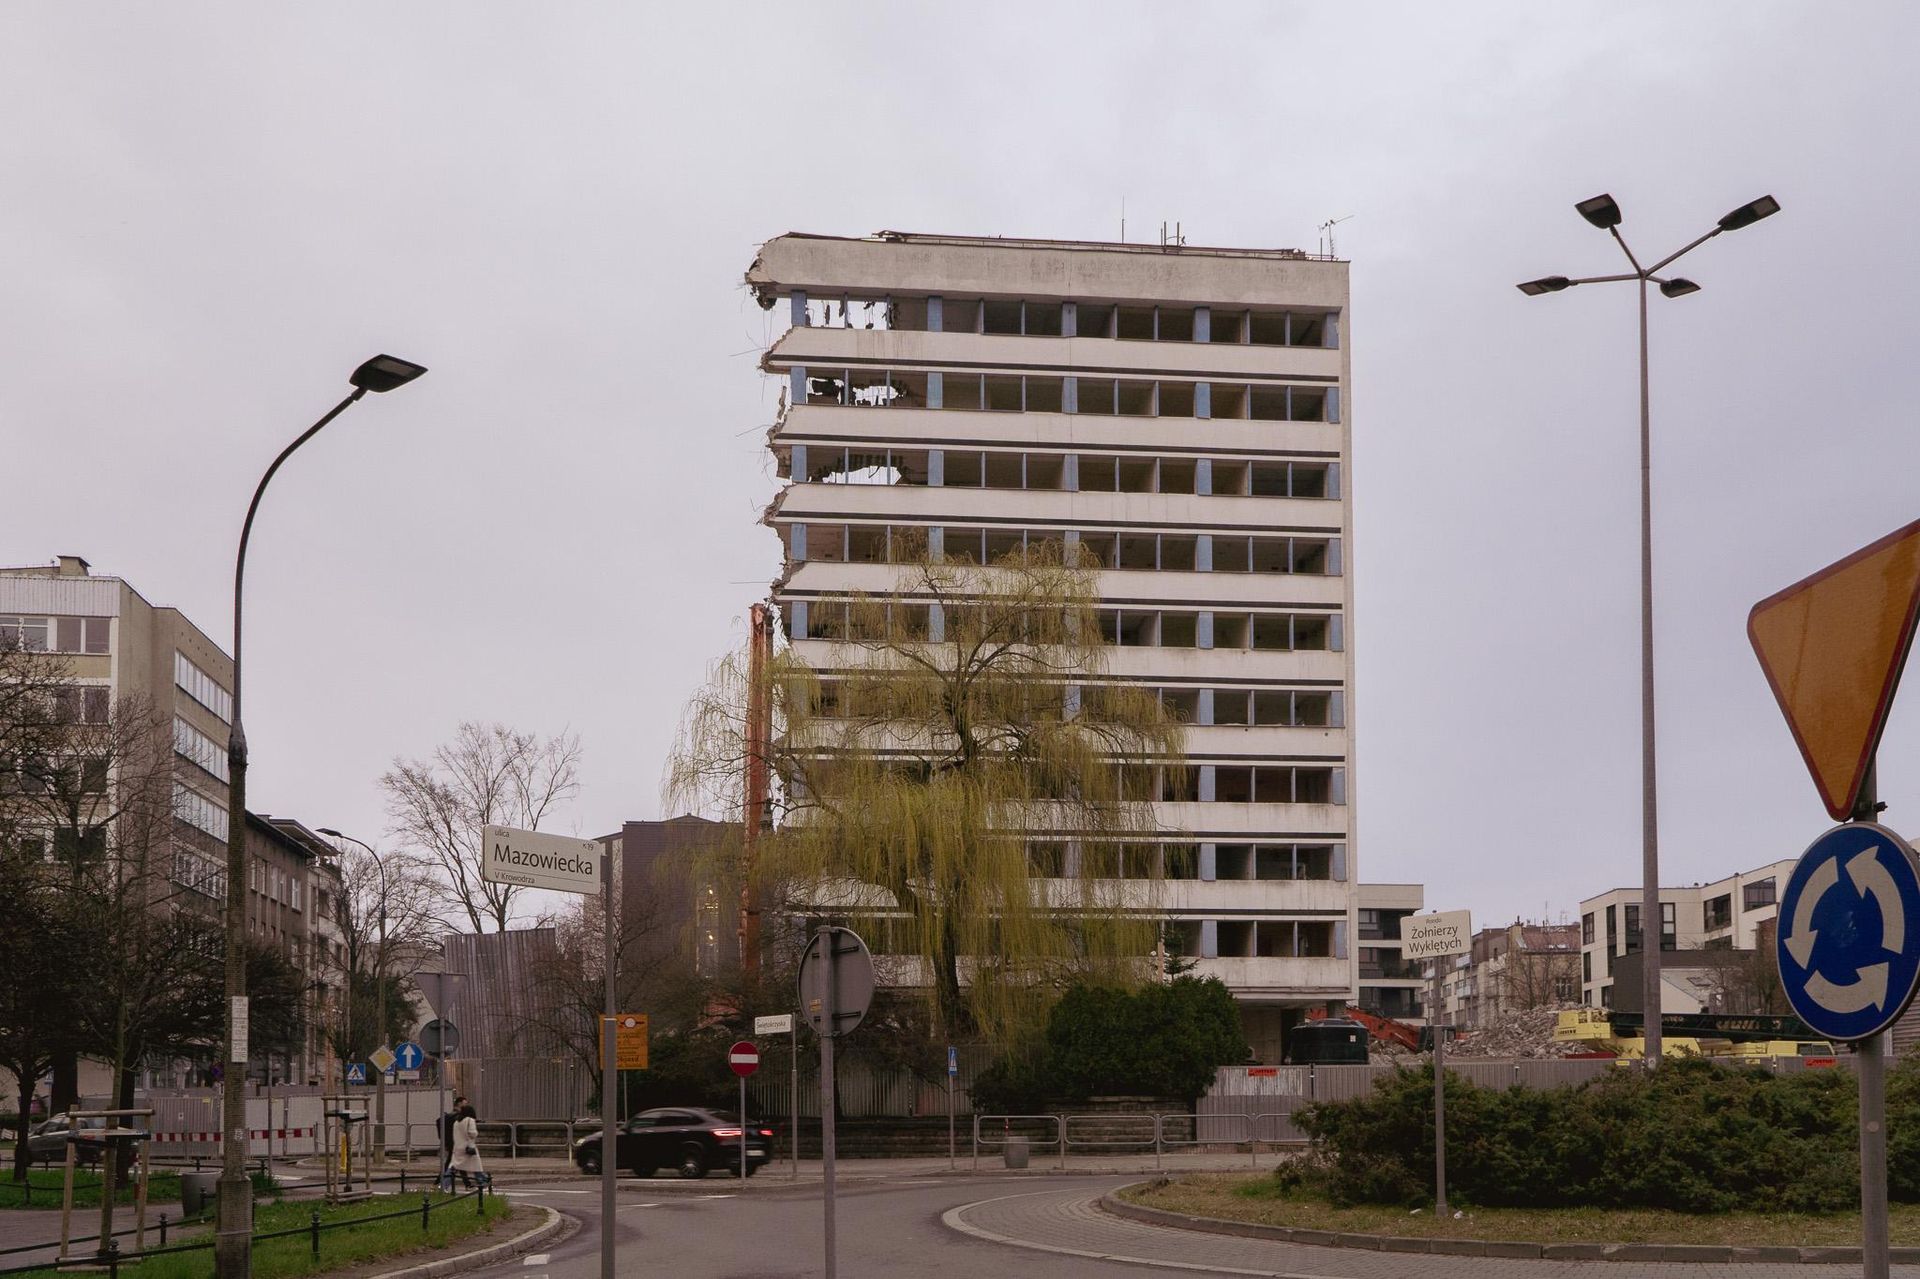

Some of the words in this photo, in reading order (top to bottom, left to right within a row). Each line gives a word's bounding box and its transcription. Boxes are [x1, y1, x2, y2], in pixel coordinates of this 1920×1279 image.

[494, 829, 510, 838] ulica
[494, 843, 593, 875] Mazowiecka
[501, 872, 536, 884] Krowodrza
[1408, 937, 1462, 955] Wyklętych
